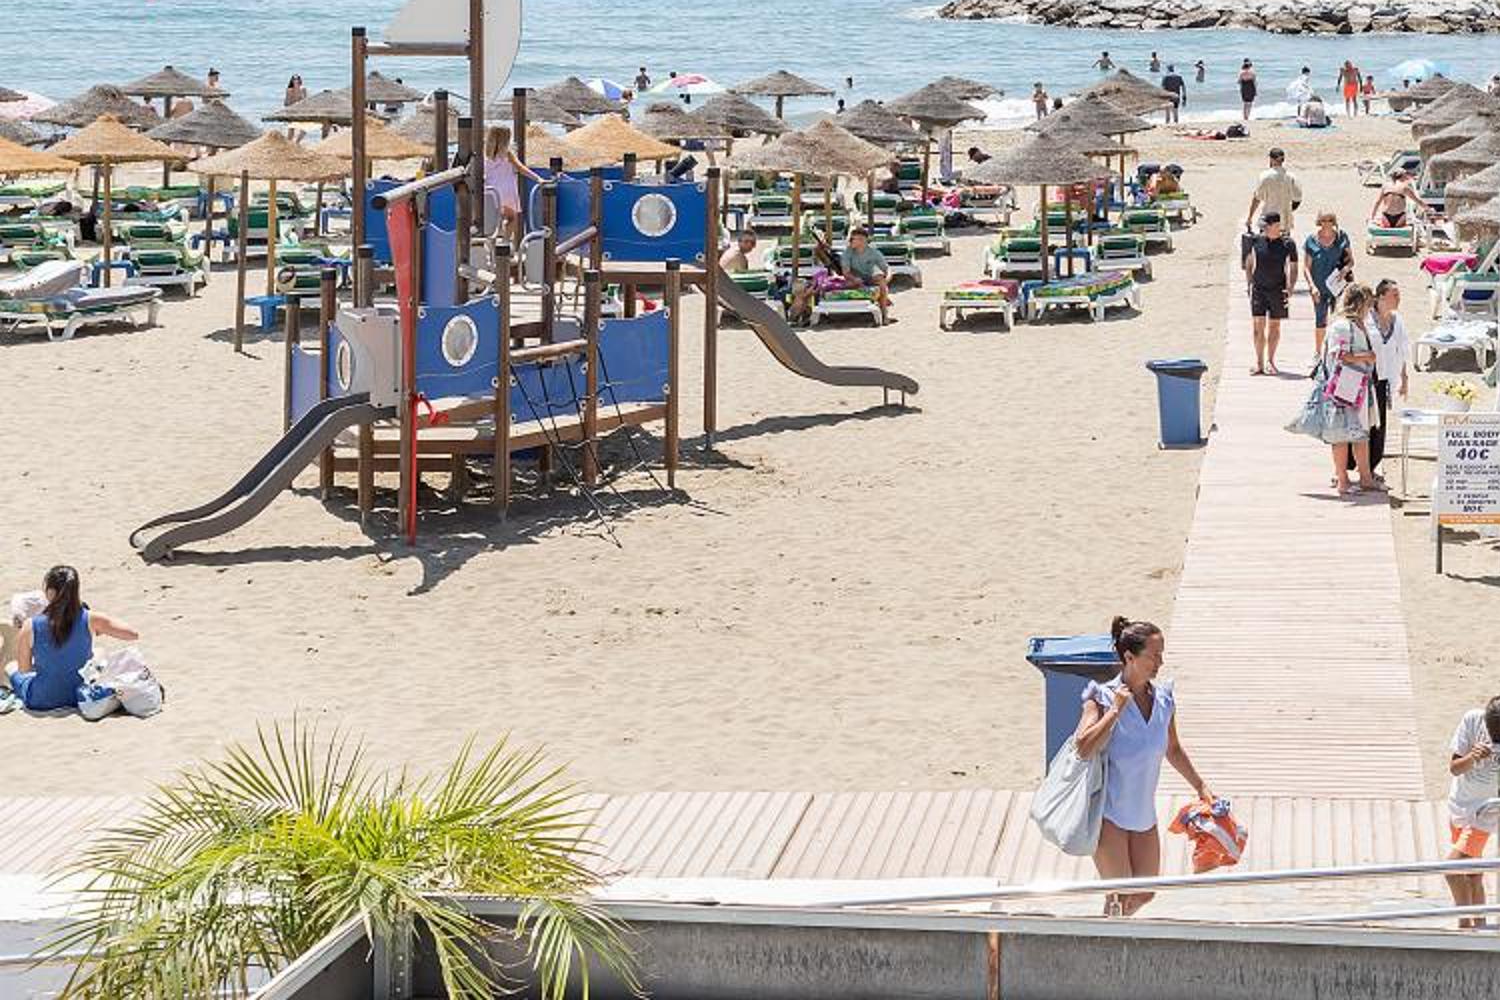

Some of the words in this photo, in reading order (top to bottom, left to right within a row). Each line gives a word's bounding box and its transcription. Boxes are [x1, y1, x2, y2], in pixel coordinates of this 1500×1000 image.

[1445, 431, 1469, 439] FULL
[1473, 431, 1500, 439] BODY
[1447, 439, 1498, 447] MASSAGE
[1455, 447, 1490, 460] 40€
